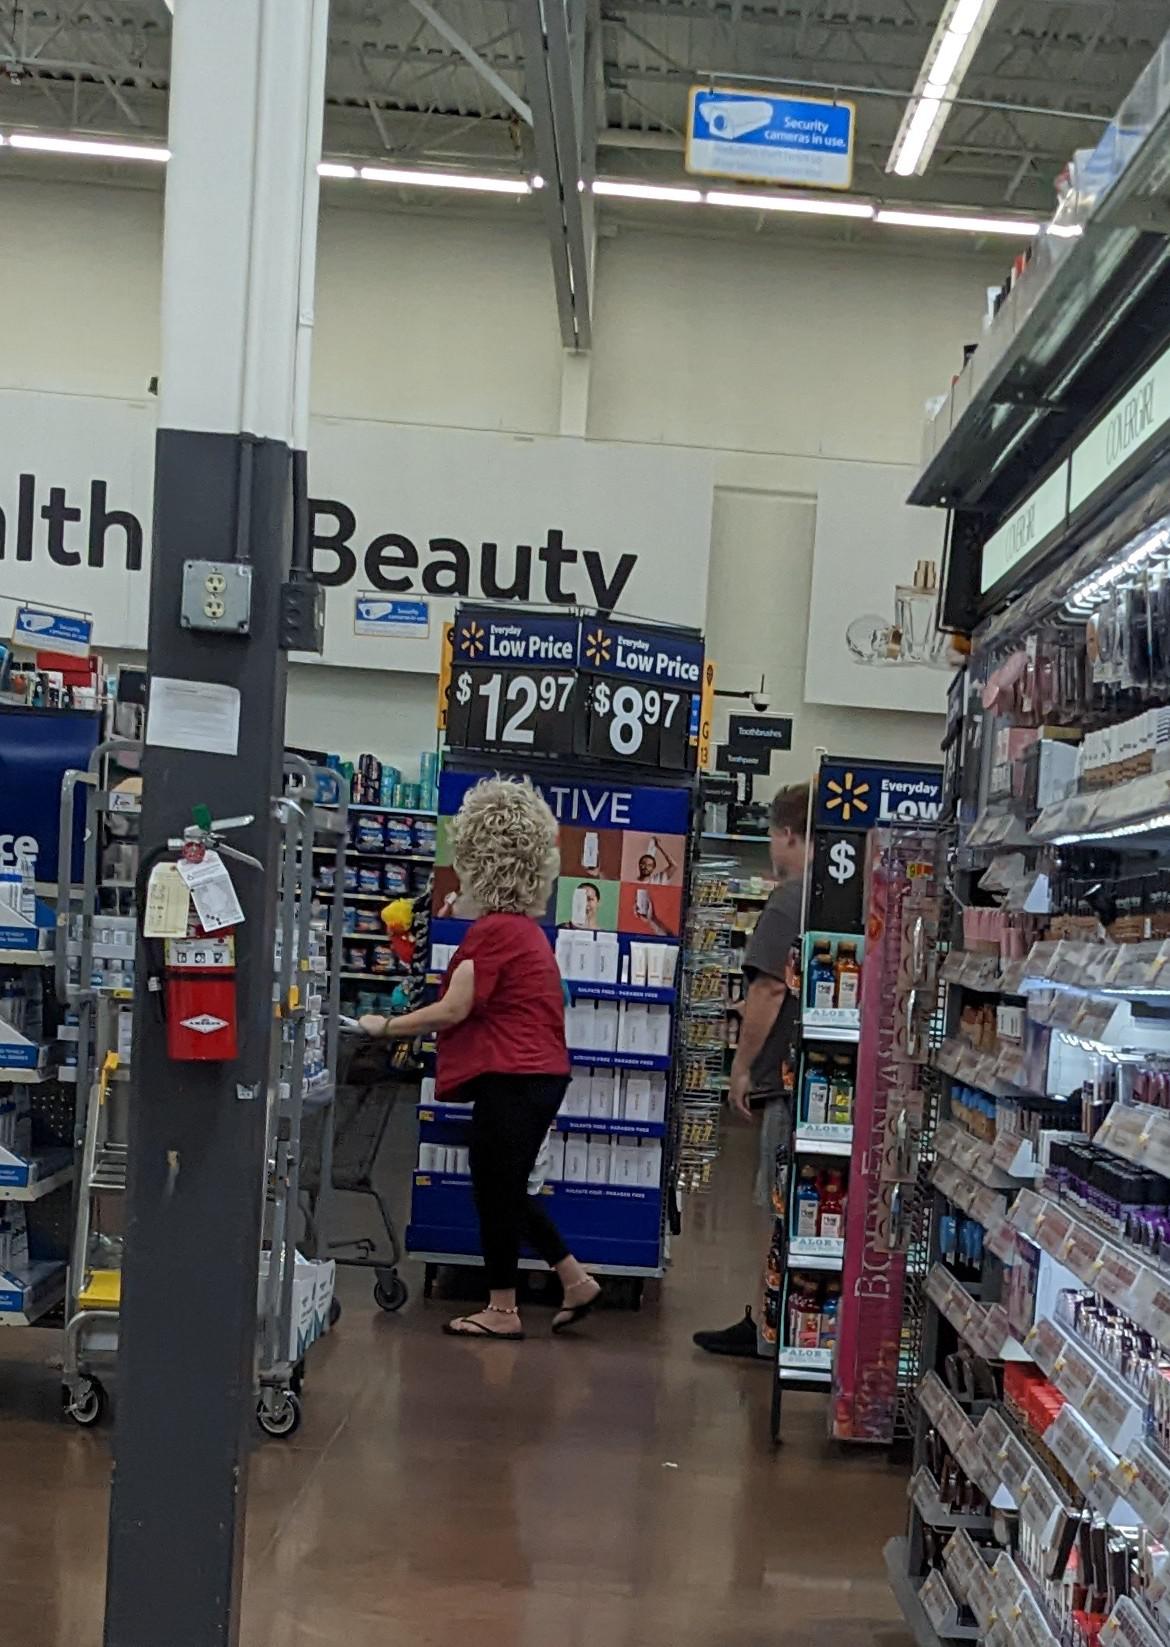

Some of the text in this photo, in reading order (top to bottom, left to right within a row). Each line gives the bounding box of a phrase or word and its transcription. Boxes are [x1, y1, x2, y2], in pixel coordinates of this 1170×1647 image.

[784, 117, 829, 134] Security
[764, 130, 846, 147] cameras in use.
[0, 473, 638, 618] lth Beauty
[490, 624, 522, 637] Everyday
[489, 634, 573, 659] Low Price
[617, 635, 650, 652] Everyday
[615, 645, 700, 681] Low Price
[881, 779, 939, 797] Everyday
[536, 785, 632, 824] TIVE
[828, 840, 855, 885] $
[812, 1009, 845, 1017] ALOE
[800, 1238, 832, 1246] ALOE
